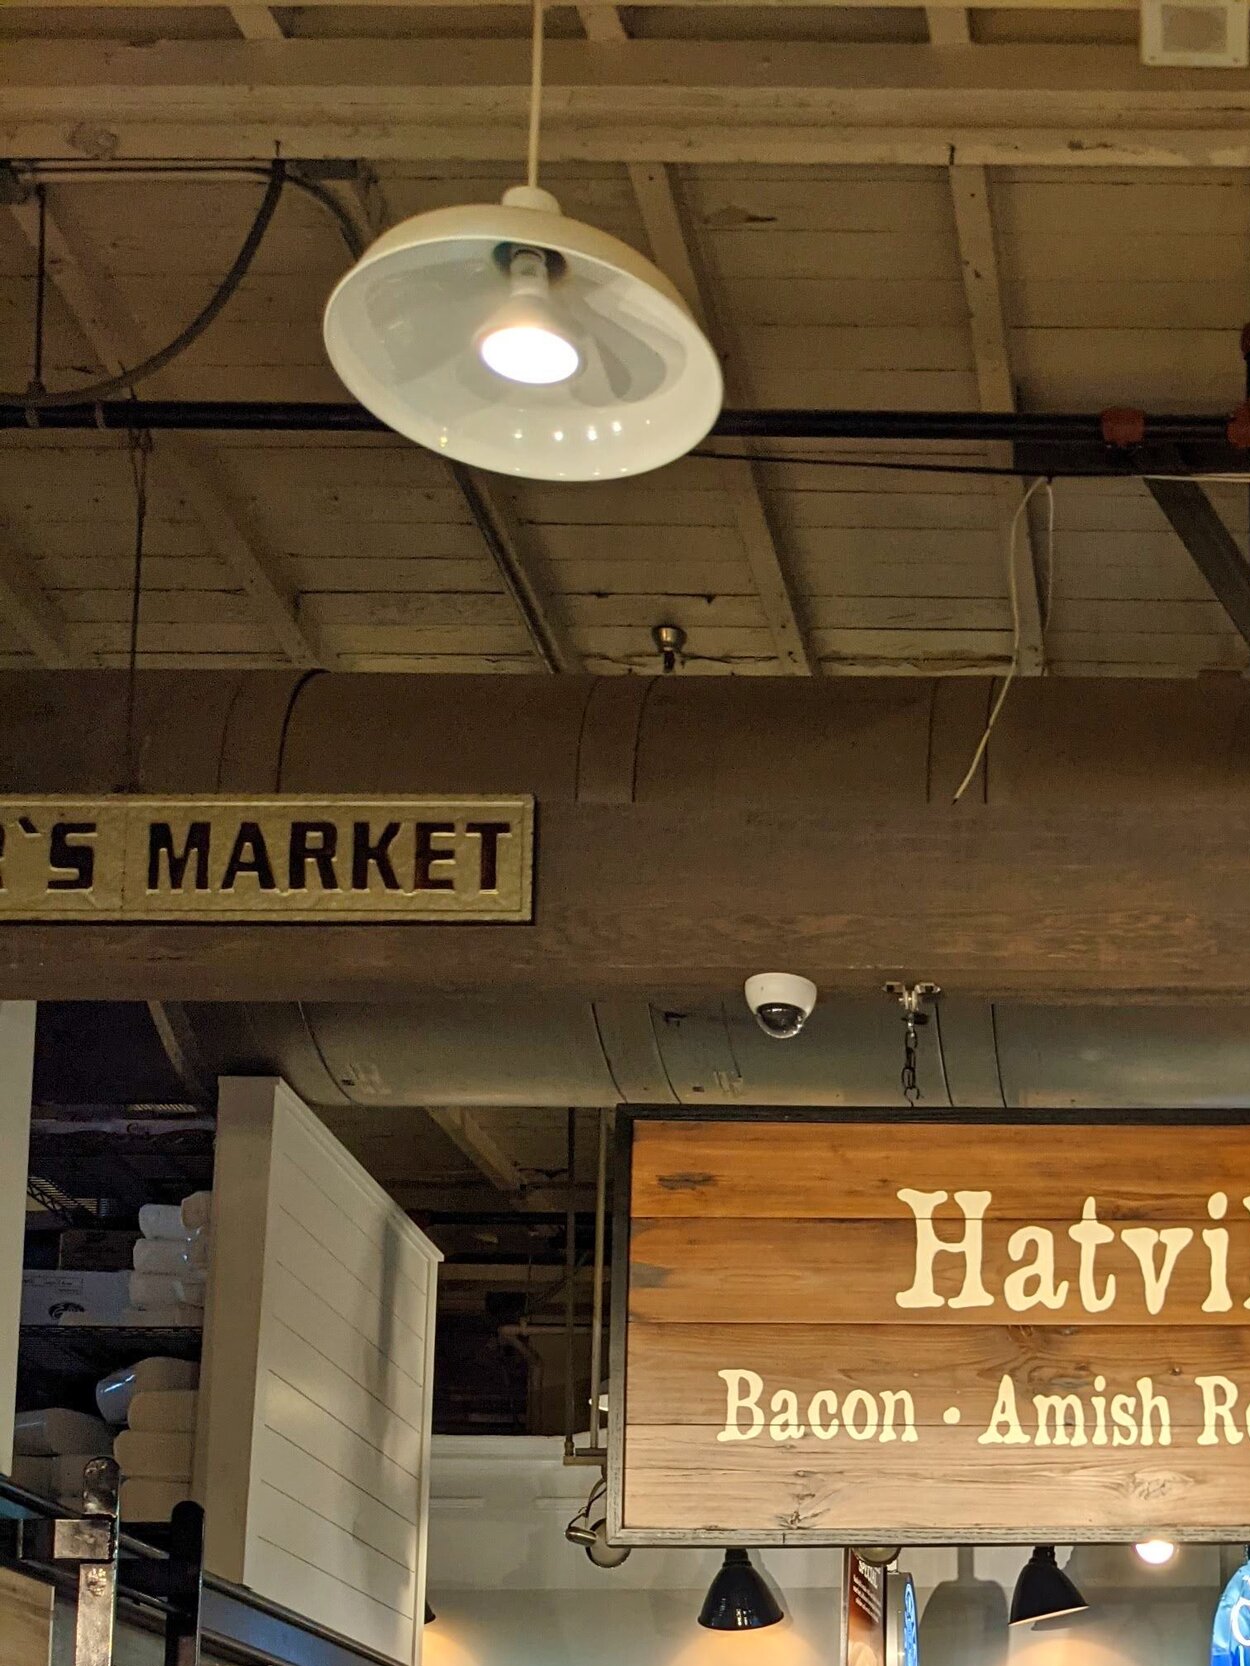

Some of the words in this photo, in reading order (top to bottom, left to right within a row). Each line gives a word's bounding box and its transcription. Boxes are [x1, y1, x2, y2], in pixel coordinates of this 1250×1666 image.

[0, 816, 97, 891] 'S
[147, 821, 511, 891] MARKET
[716, 1367, 919, 1444] Bacon
[977, 1373, 1172, 1447] Amish
